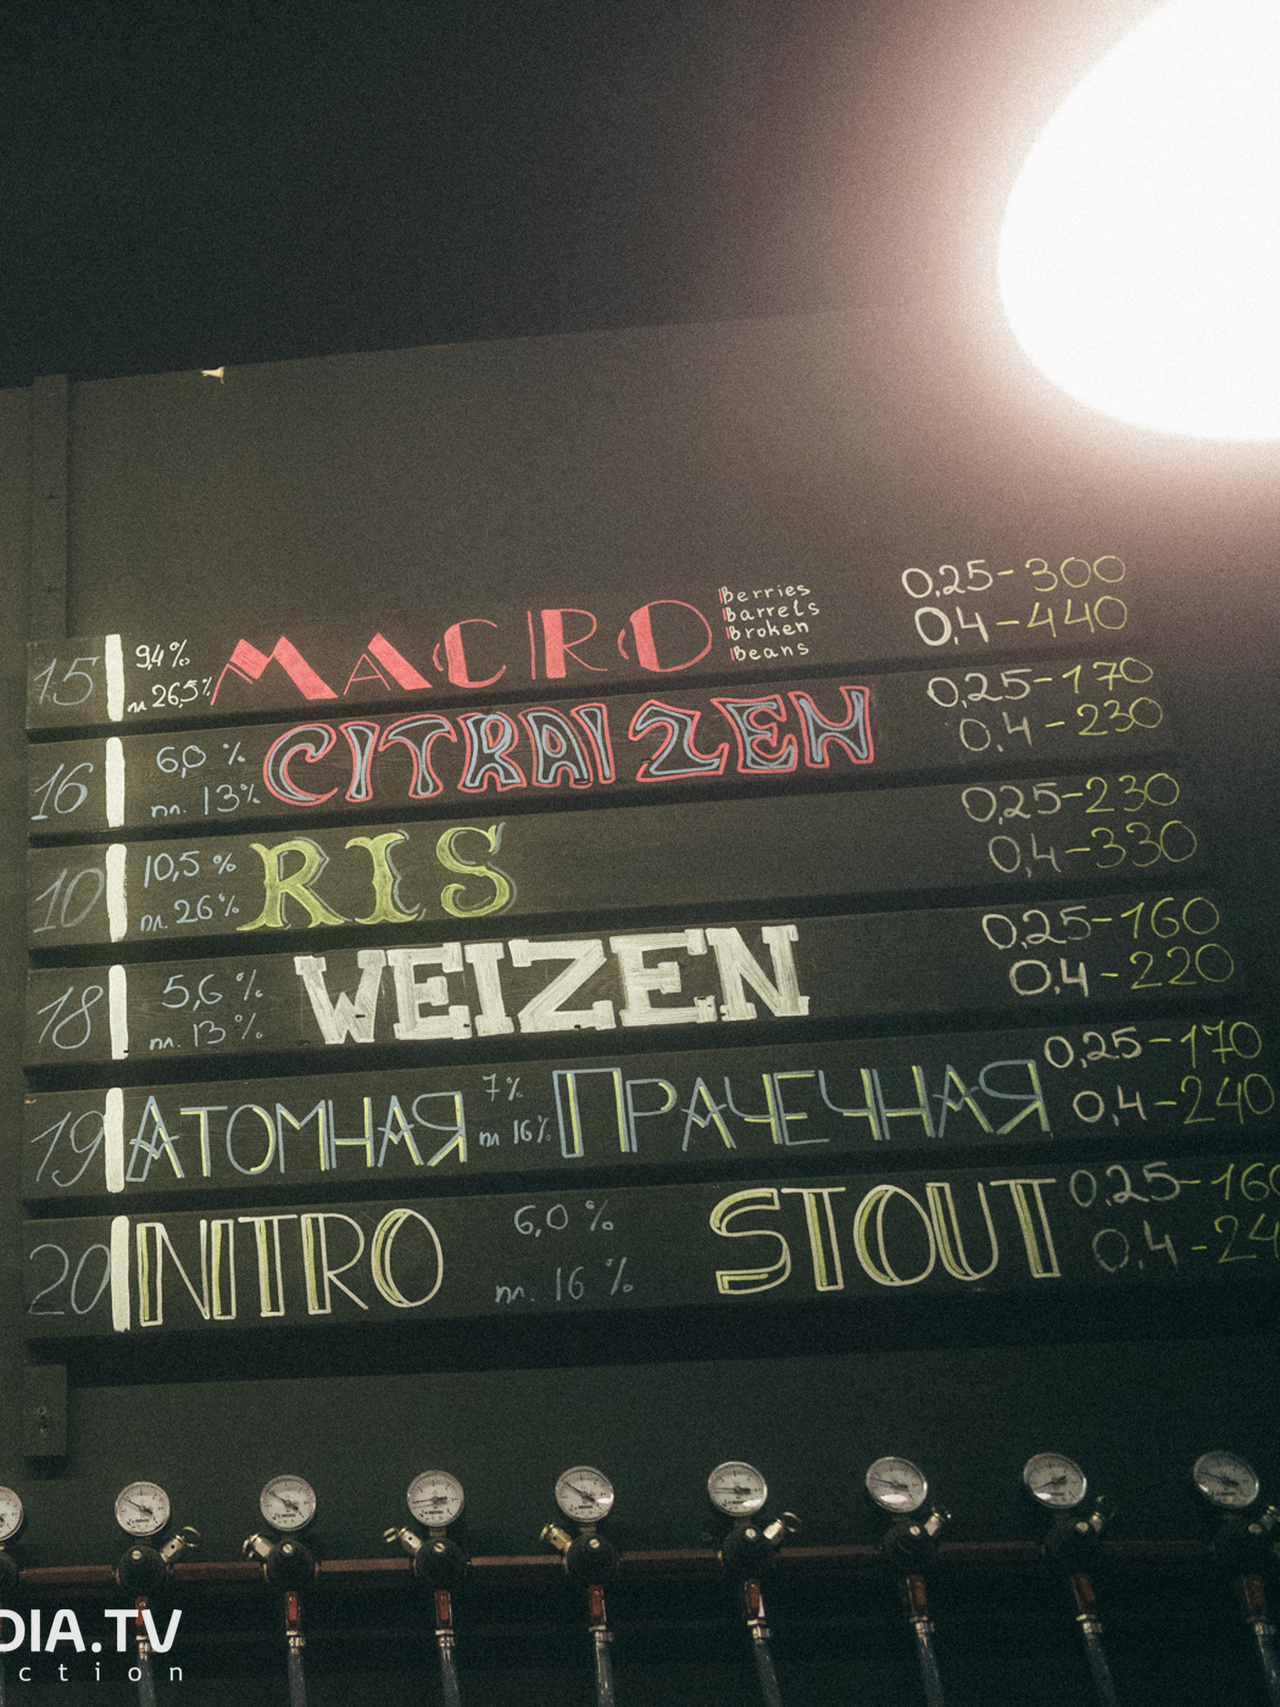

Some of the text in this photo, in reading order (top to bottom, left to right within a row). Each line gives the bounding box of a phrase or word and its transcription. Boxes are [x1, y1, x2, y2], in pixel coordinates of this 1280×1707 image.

[718, 584, 811, 605] Berries
[722, 599, 820, 622] Barrels
[726, 619, 809, 641] Broken
[33, 656, 101, 706] 15
[211, 600, 713, 706] MACRO
[730, 643, 810, 662] Beans
[31, 762, 94, 820] 16
[33, 868, 105, 933] 10
[236, 822, 517, 932] RIS
[36, 985, 105, 1050] 18
[294, 924, 810, 1045] WEIZEN
[126, 1091, 468, 1182] АТОМНАЯ
[552, 1060, 1051, 1158] ПРАЧЕЧНАЯ
[30, 1110, 107, 1187] 19
[136, 1208, 444, 1327] NITRO
[709, 1179, 1061, 1295] STOUT
[28, 1243, 111, 1315] 20
